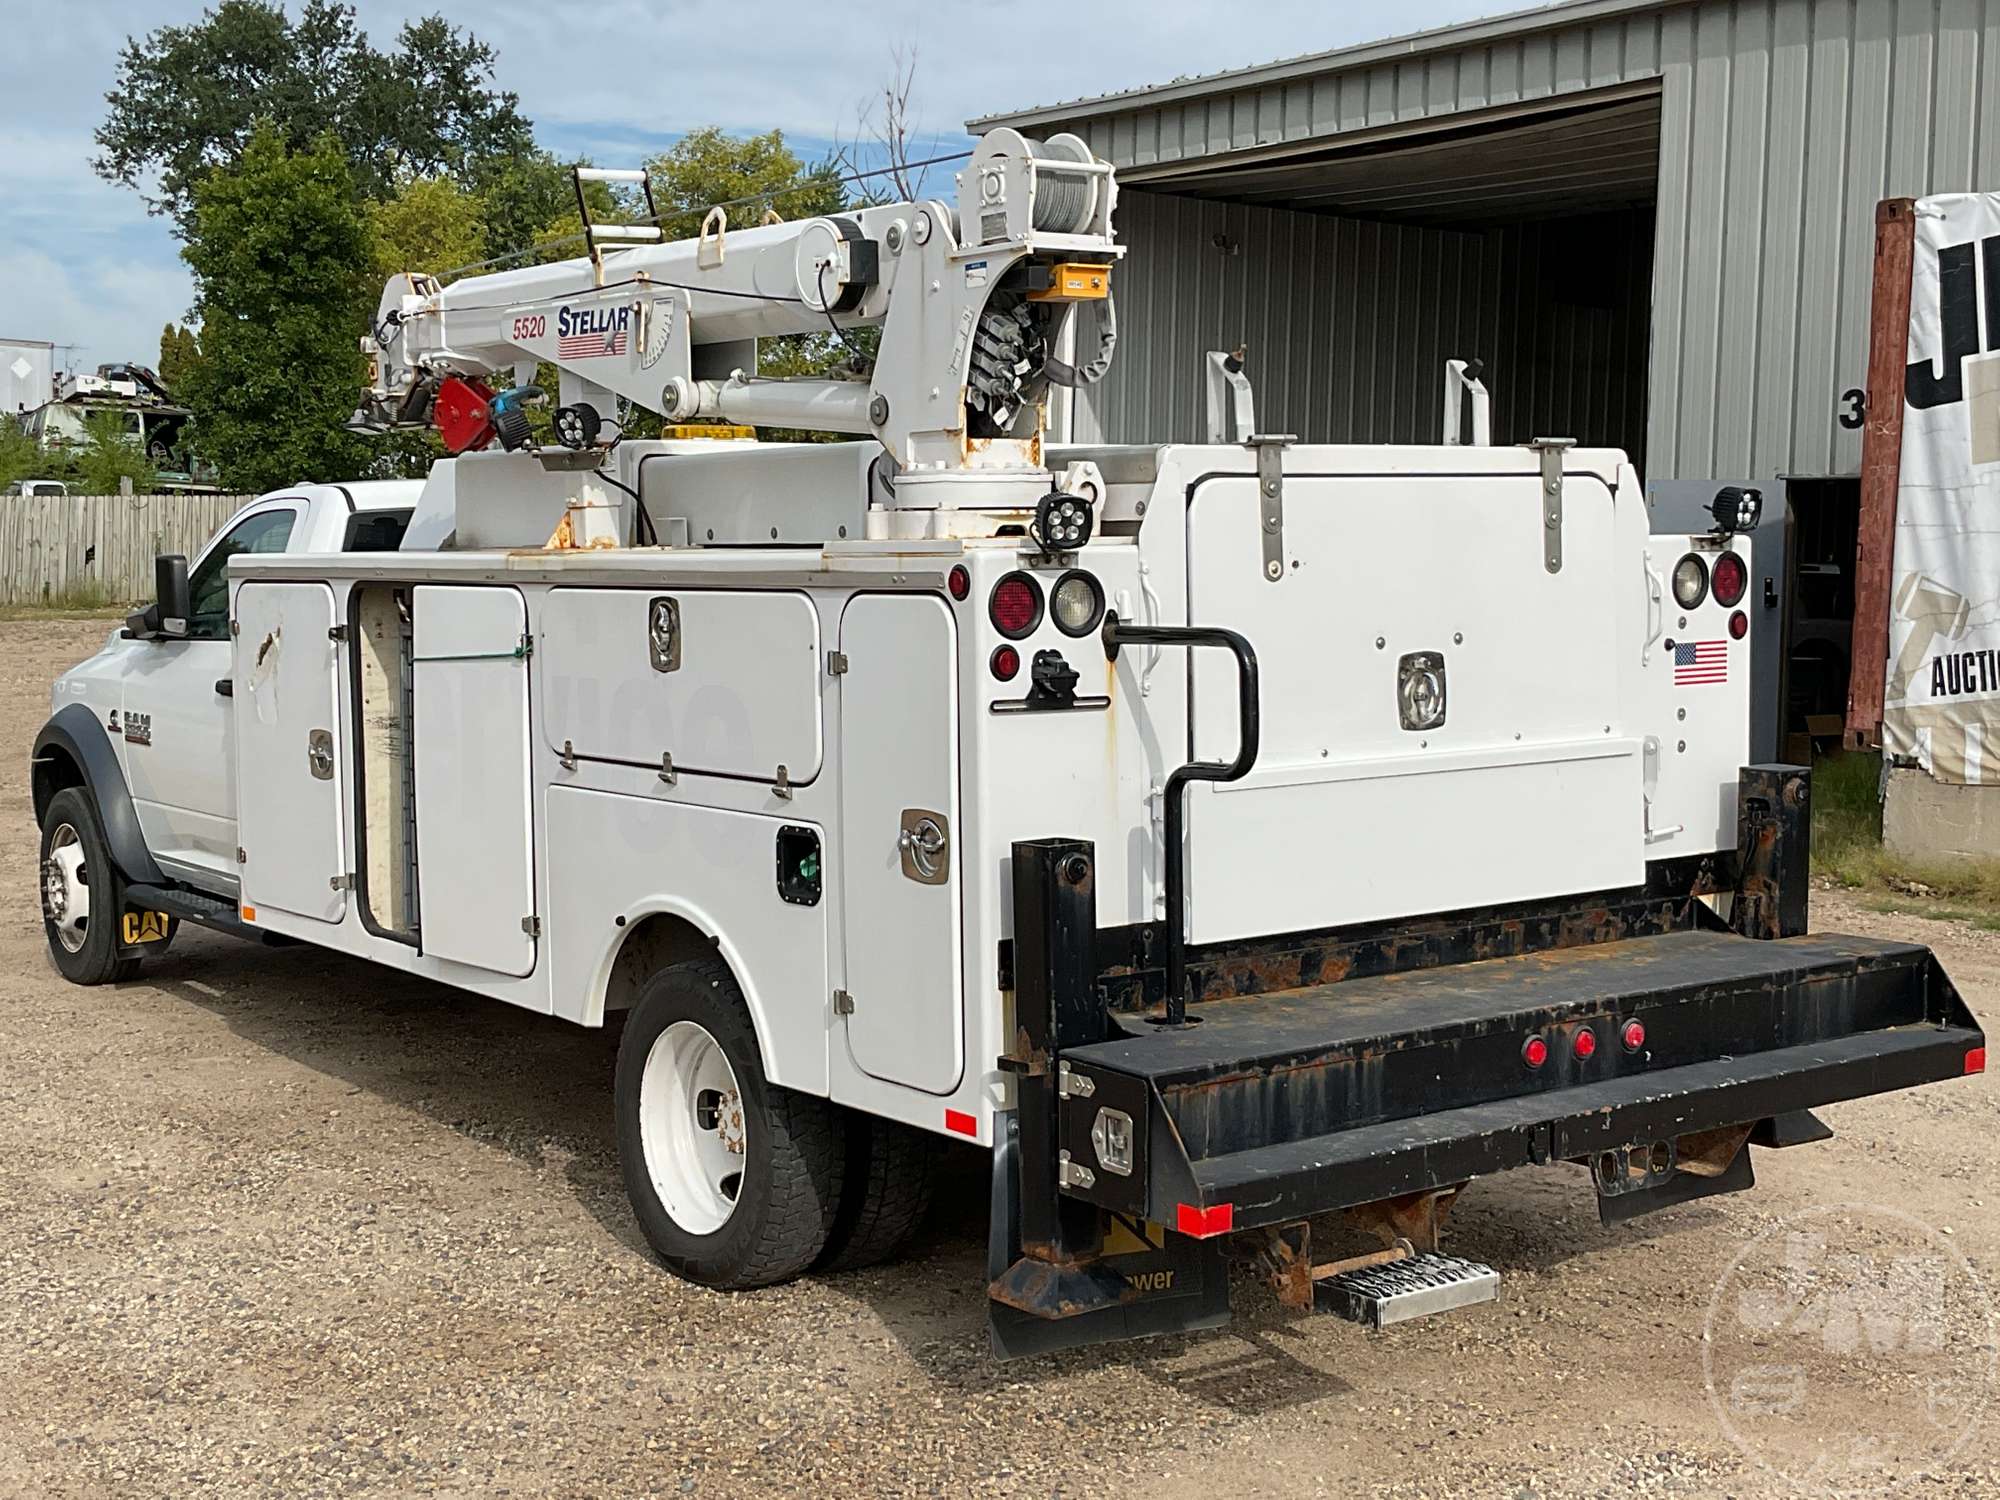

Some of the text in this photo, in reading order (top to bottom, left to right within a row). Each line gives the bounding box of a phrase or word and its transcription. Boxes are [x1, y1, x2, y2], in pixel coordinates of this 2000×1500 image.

[513, 315, 545, 340] 5520
[1839, 389, 1866, 429] 3
[1931, 649, 2000, 697] AUCTI
[123, 911, 169, 944] CAT
[1124, 1270, 1175, 1290] wer
